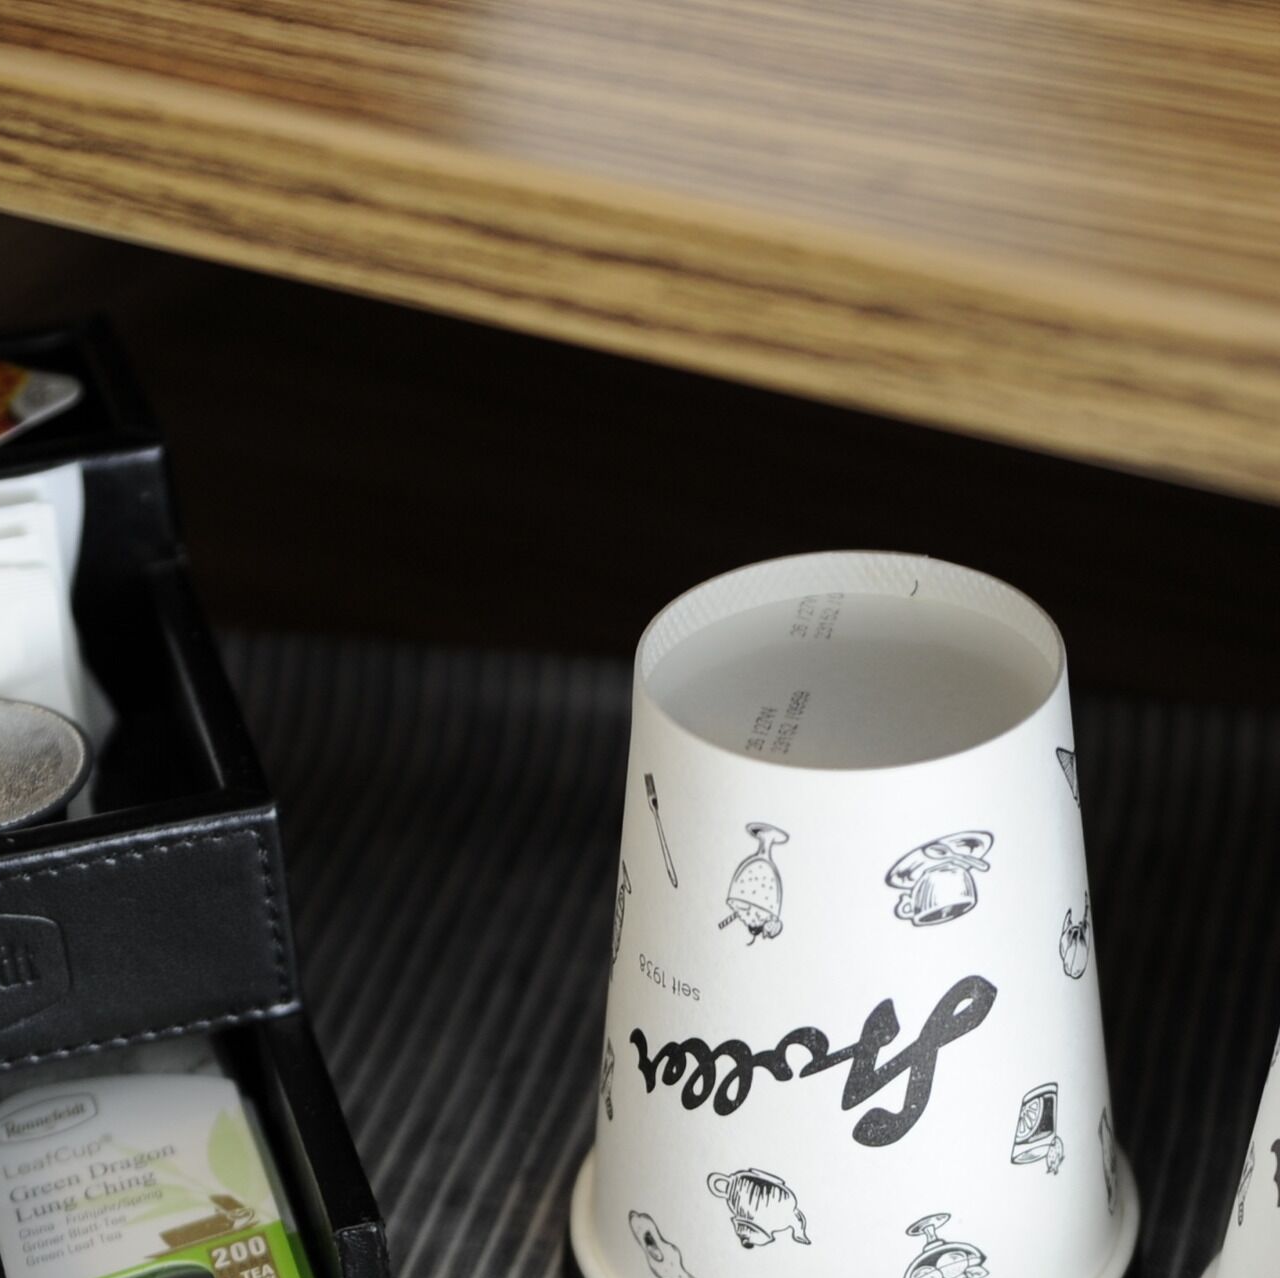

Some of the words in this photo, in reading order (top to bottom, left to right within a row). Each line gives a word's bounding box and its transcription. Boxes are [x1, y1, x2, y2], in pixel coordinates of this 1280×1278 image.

[638, 952, 667, 990] 1938
[671, 975, 702, 1002] seit
[8, 1172, 81, 1204] Green
[88, 1144, 177, 1181] Dragon
[15, 1196, 79, 1224] Lung
[83, 1170, 157, 1202] Ching
[211, 1235, 267, 1270] 200
